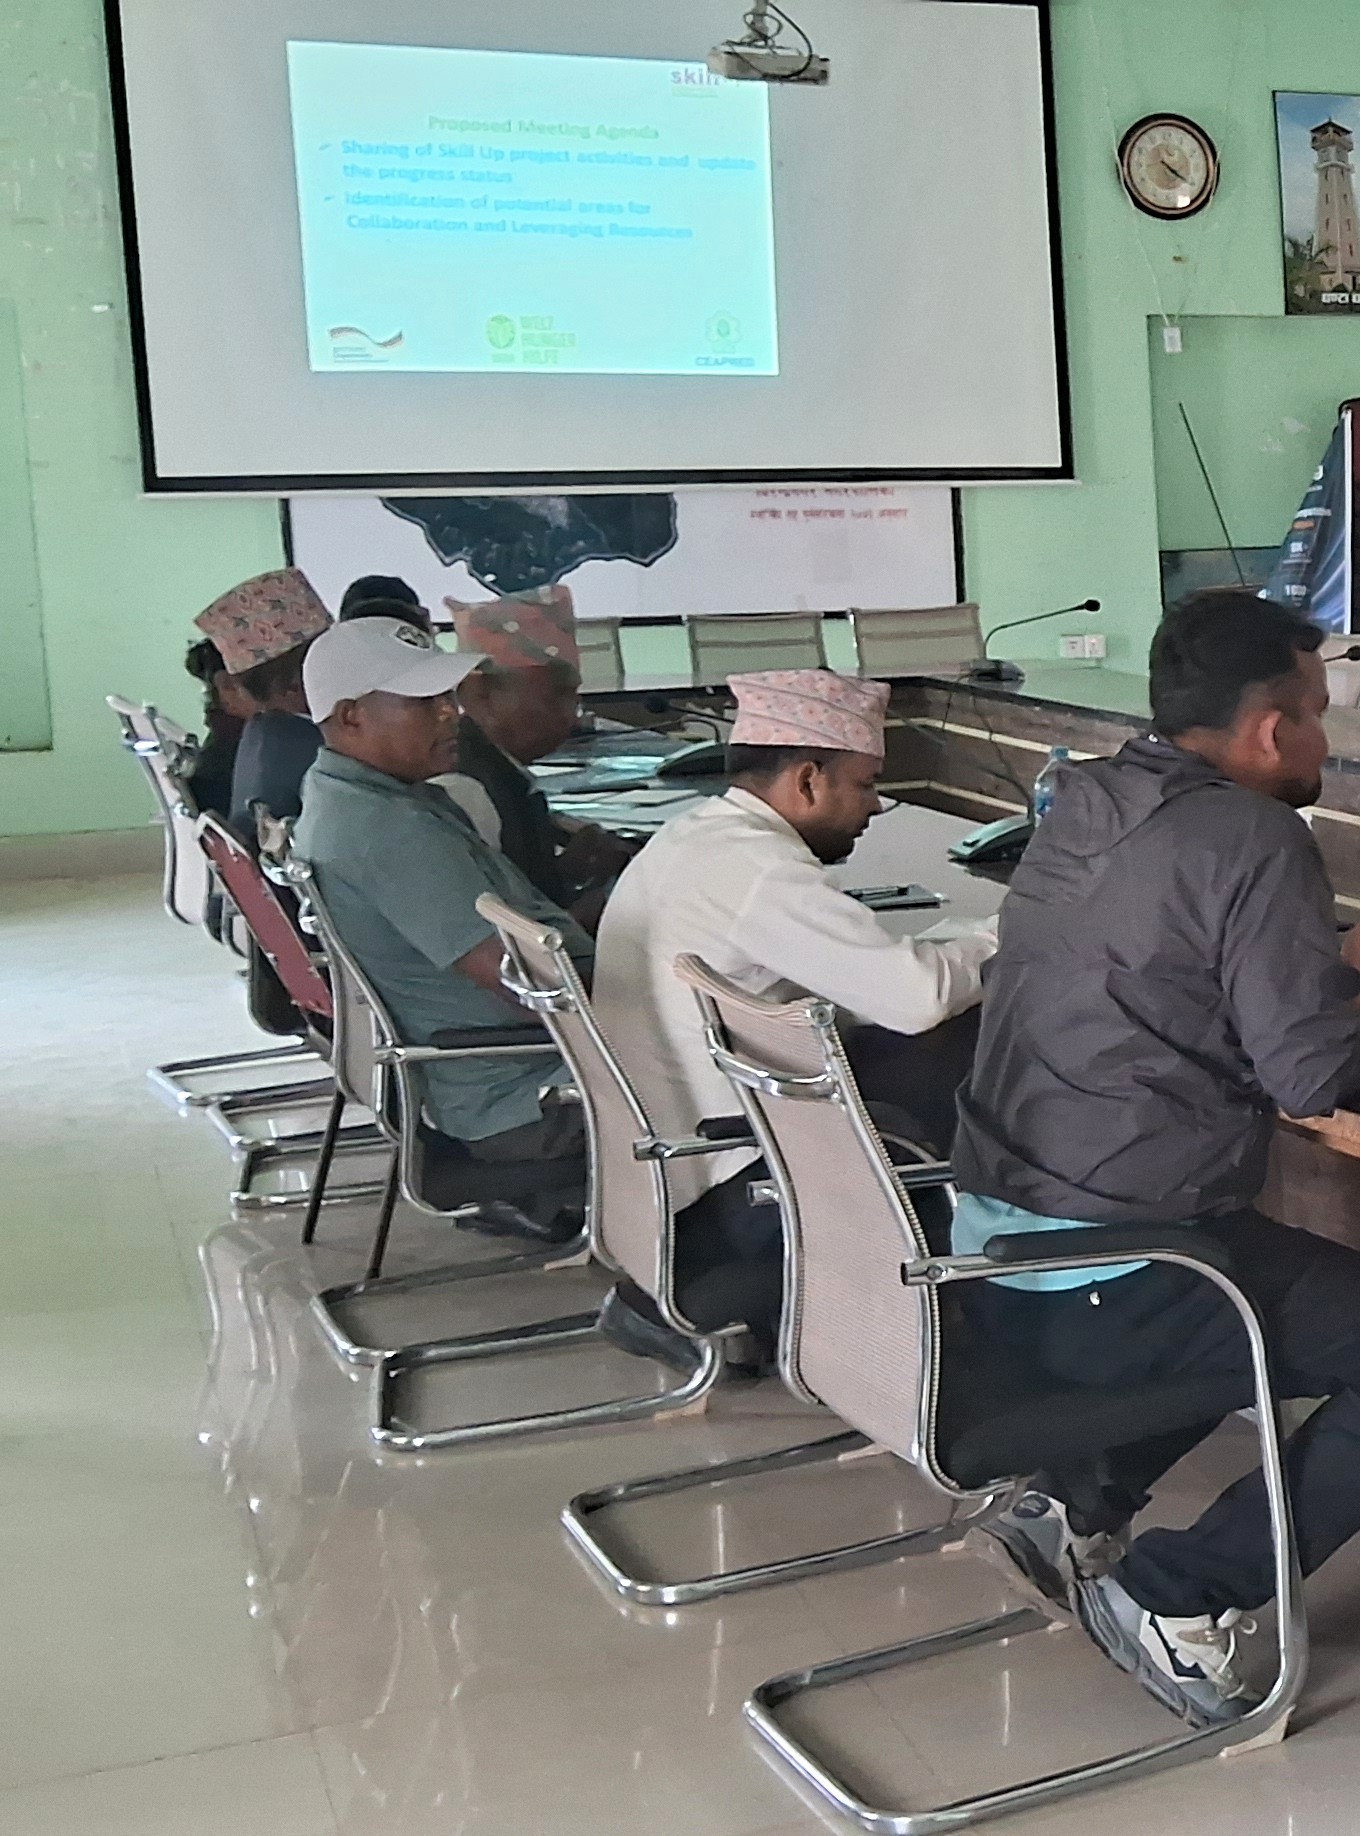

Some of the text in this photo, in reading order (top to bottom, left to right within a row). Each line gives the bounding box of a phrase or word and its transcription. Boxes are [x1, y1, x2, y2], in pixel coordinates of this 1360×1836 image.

[429, 115, 659, 141] Proposed Meeting Agenda
[342, 140, 409, 159] Sharing
[415, 142, 433, 156] of
[439, 143, 474, 158] Skill
[480, 145, 505, 162] Up
[510, 149, 569, 165] project
[577, 151, 652, 167] activities
[658, 154, 689, 167] and
[343, 163, 513, 183] the progress status
[345, 191, 465, 209] Identification
[470, 194, 488, 209] of
[494, 197, 572, 212] potential
[346, 214, 468, 231] Collaboration
[474, 219, 506, 232] and
[512, 220, 604, 238] Leveraging
